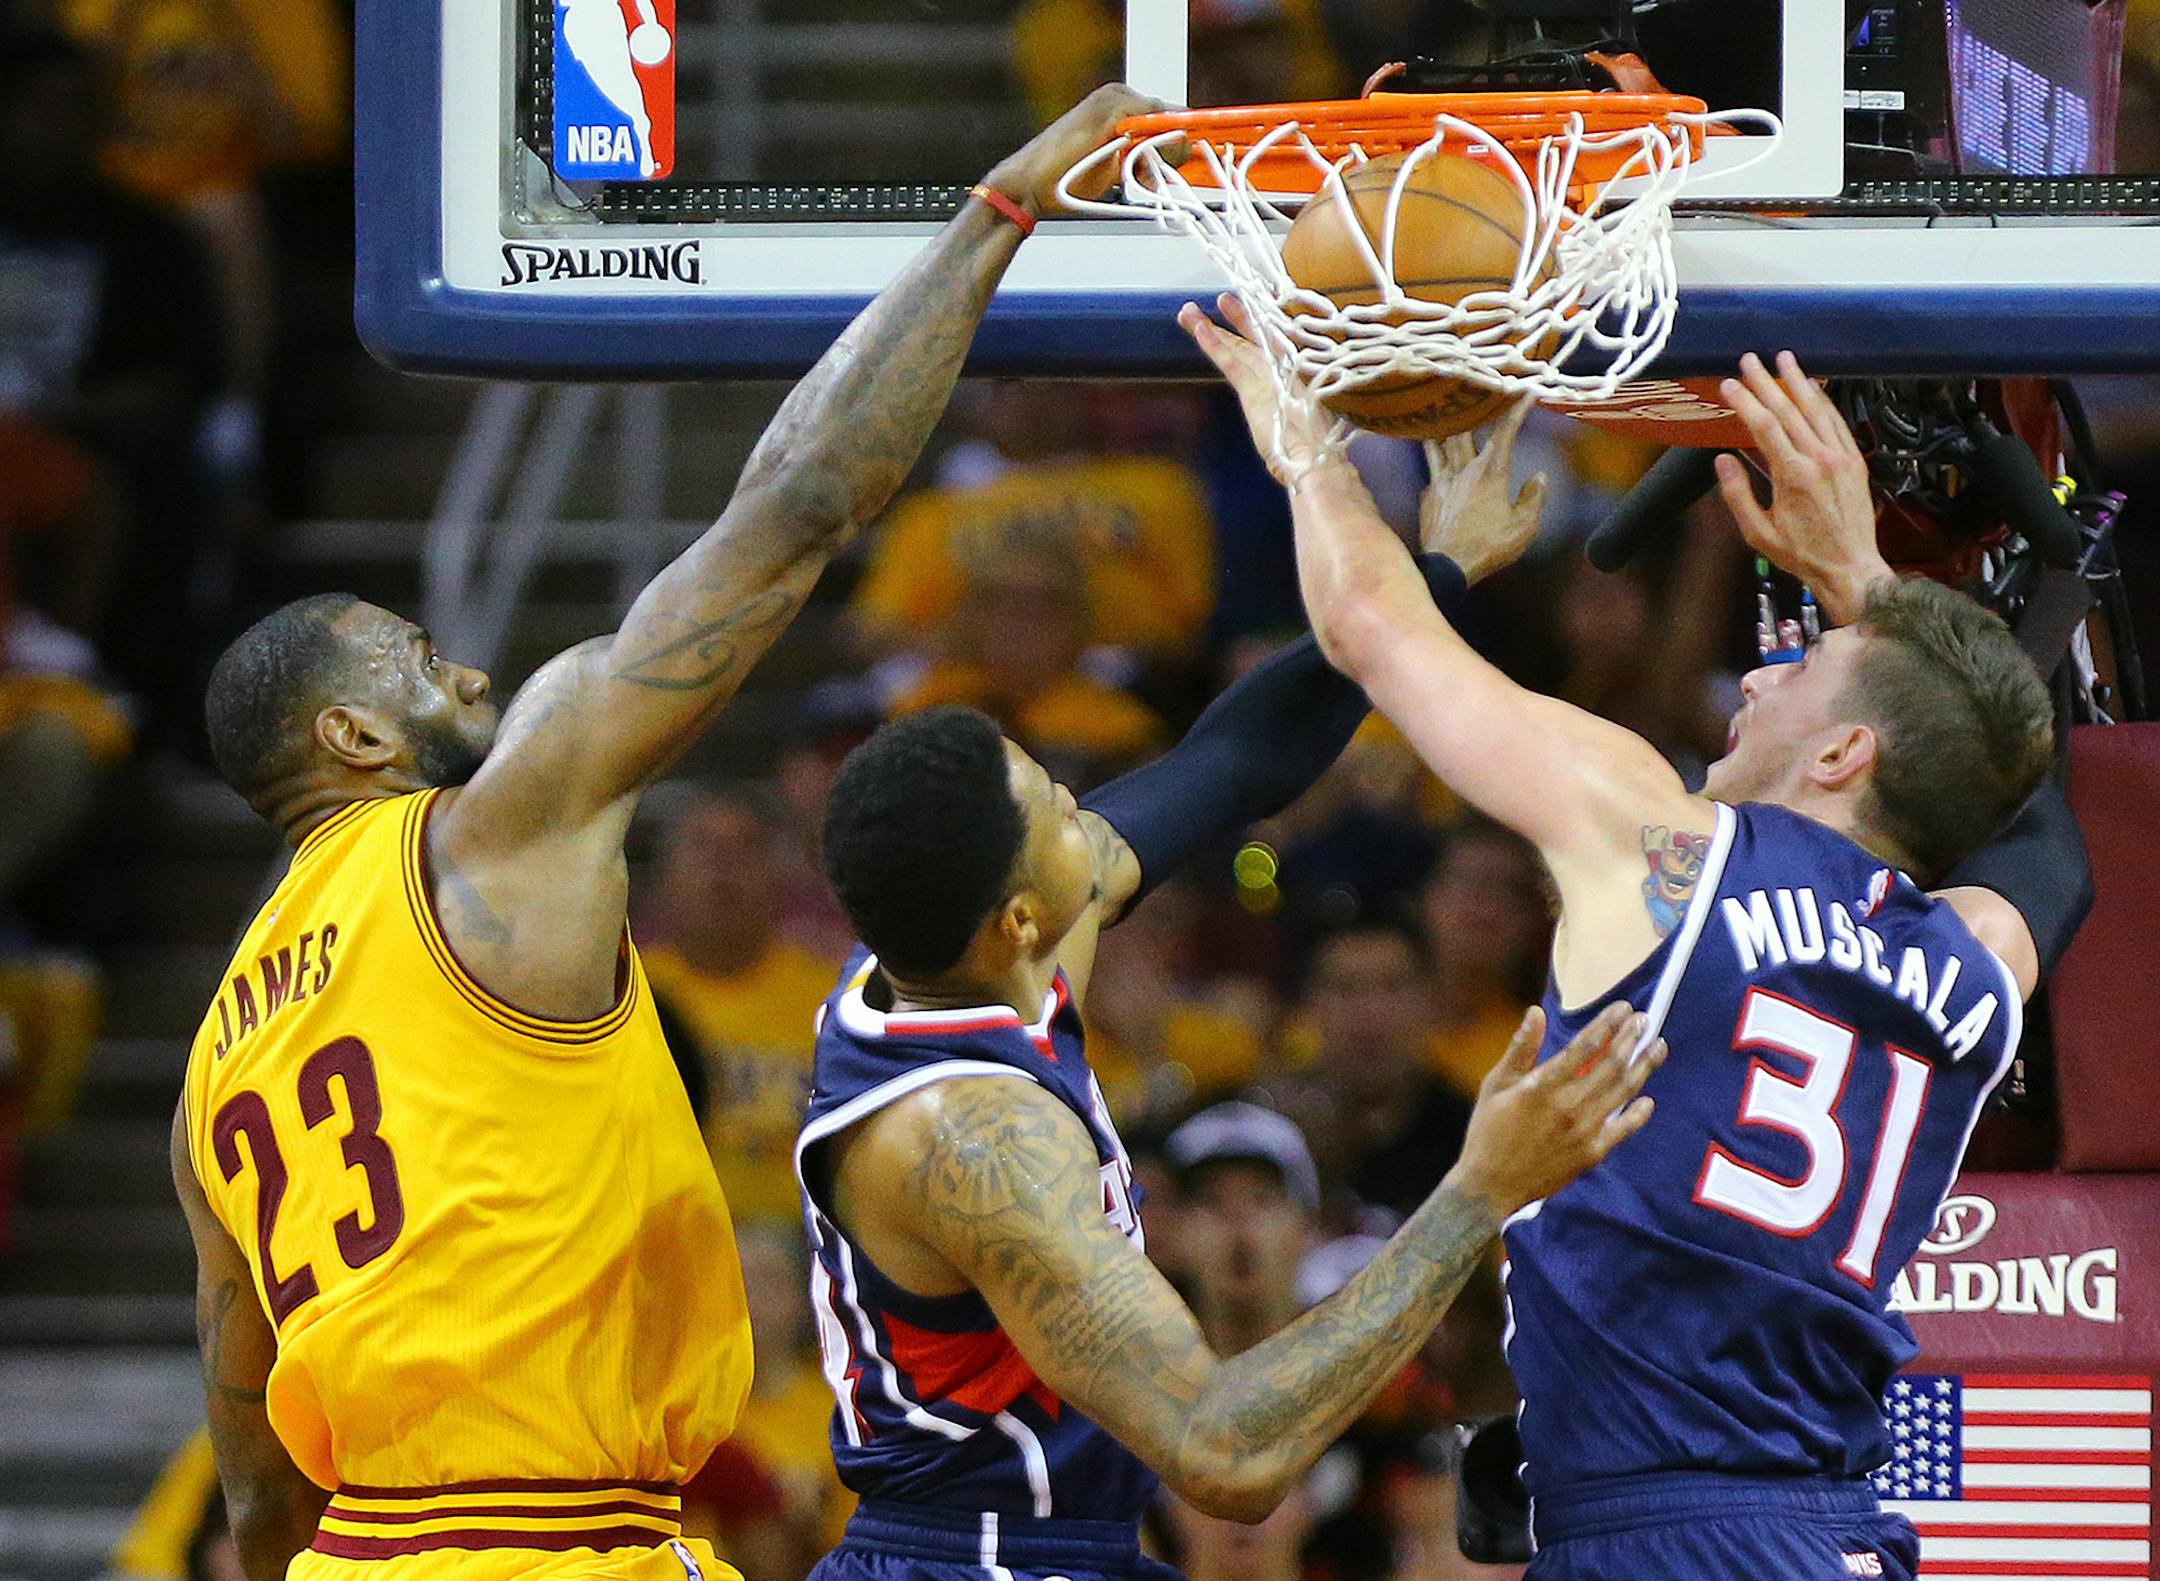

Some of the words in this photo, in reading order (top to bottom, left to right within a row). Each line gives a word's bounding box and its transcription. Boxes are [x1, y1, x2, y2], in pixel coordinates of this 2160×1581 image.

[568, 126, 635, 163] NBA
[501, 240, 700, 287] SPALDING
[214, 922, 339, 1061] JAMES
[1722, 887, 1998, 1061] MUSCALA
[212, 1034, 405, 1331] 23
[1692, 985, 1934, 1290] 31
[1885, 1247, 2118, 1323] ALDING
[1841, 1552, 1883, 1576] WKS
